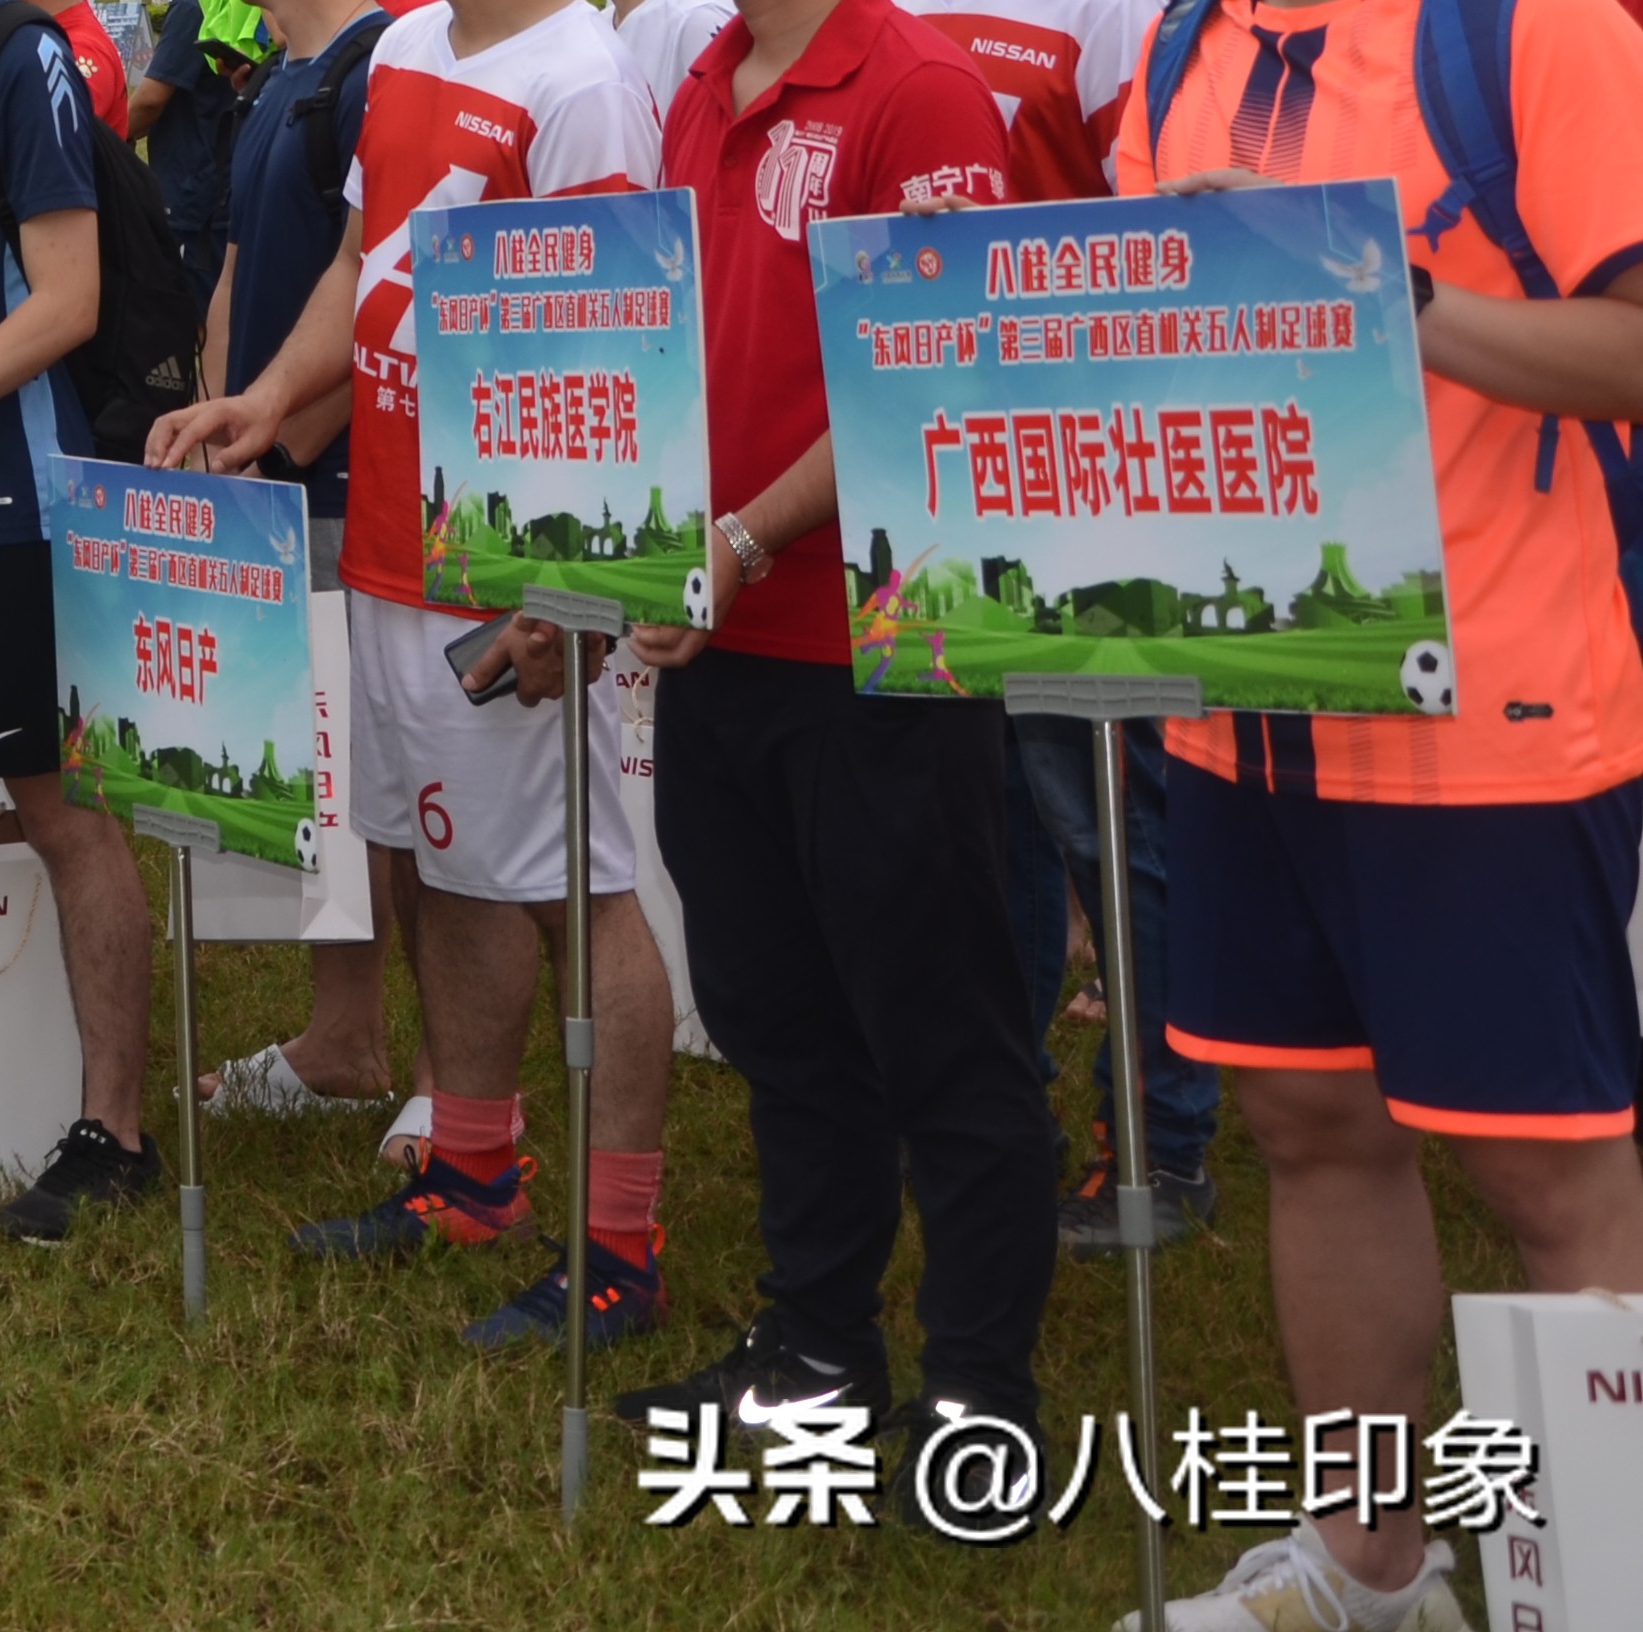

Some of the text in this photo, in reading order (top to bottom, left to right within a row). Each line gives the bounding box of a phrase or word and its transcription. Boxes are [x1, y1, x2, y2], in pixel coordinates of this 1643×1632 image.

[970, 37, 1057, 70] NISSAN
[454, 111, 515, 147] NISSAN
[494, 226, 595, 279] 八桂全民健身
[987, 230, 1191, 298] 八桂全民健身
[471, 369, 639, 464] 右江民族医学院
[921, 403, 1319, 519] 广西国际壮医医院
[124, 488, 216, 544] 八桂全民健身
[133, 613, 220, 706] 东风日产
[417, 779, 454, 851] 6
